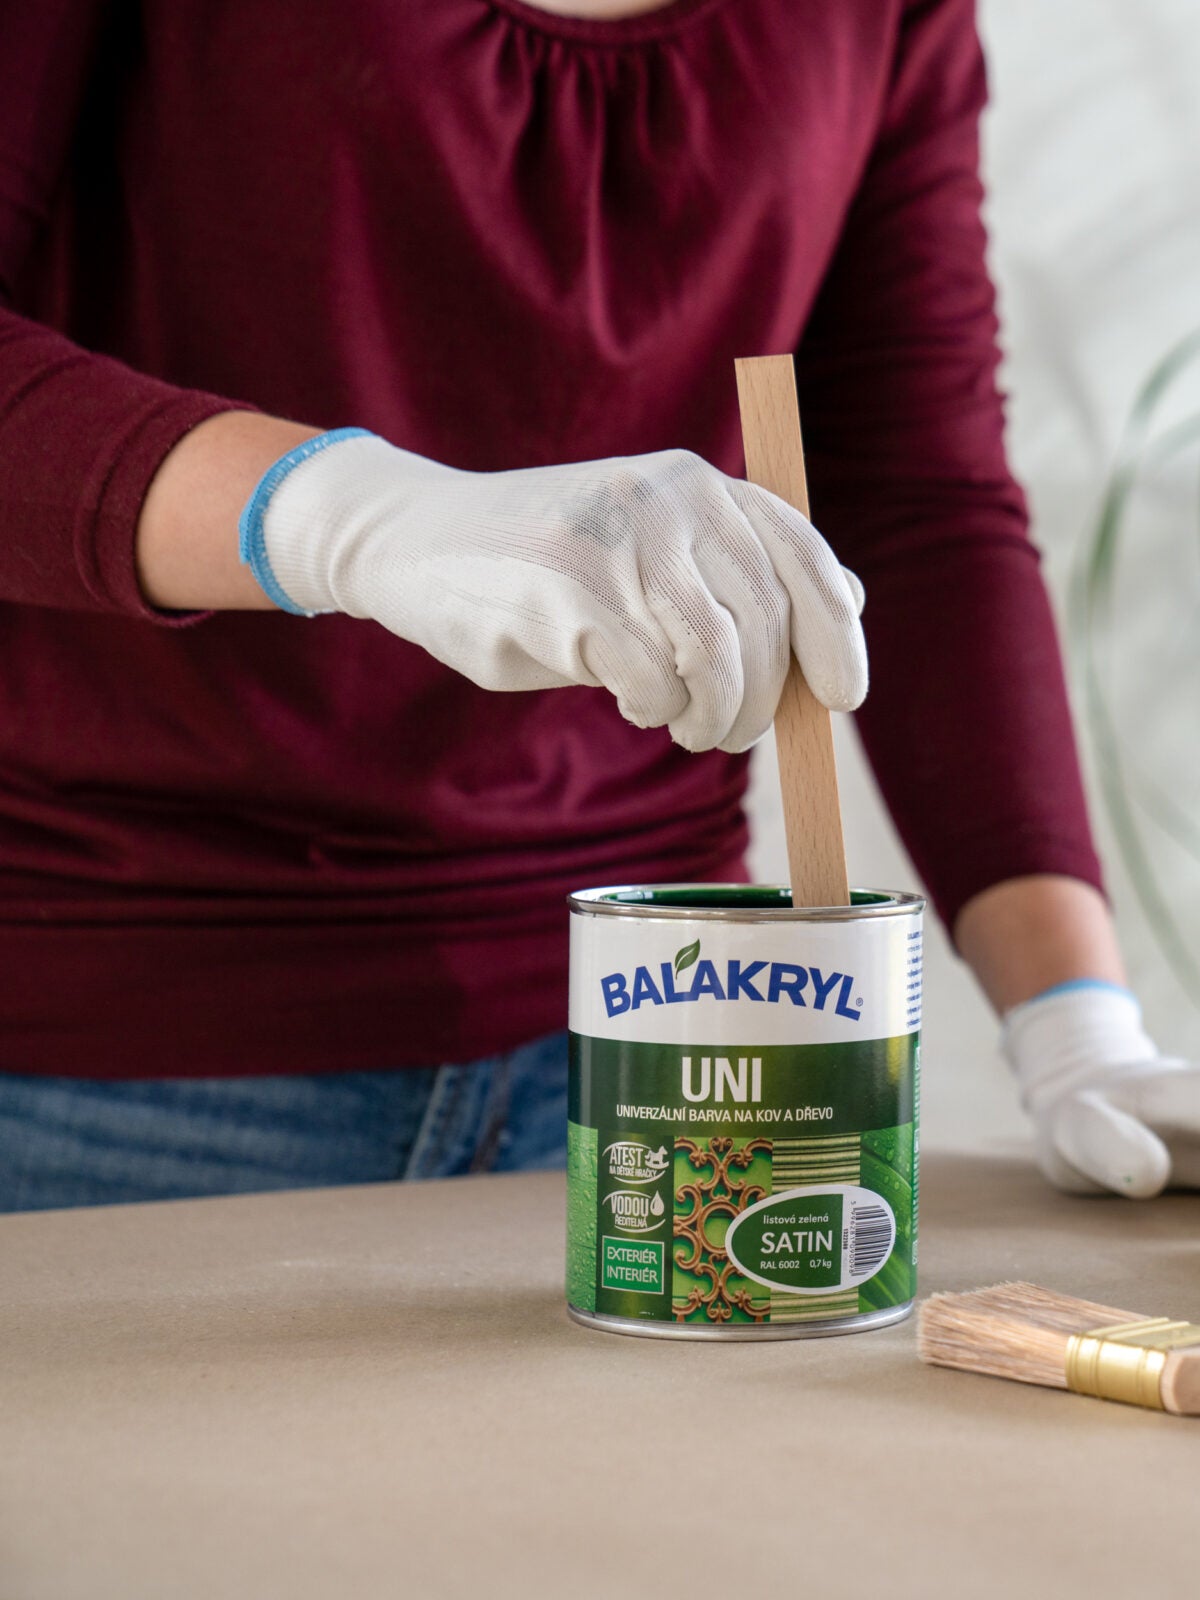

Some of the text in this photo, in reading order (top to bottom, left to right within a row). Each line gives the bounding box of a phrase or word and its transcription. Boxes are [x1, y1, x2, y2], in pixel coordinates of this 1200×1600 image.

[600, 959, 861, 1021] BALAKRYL
[681, 1056, 762, 1103] UNI
[616, 1104, 833, 1122] UNIVERZÁLNÍ BARVA NA KOV A DŘEVO
[609, 1145, 643, 1167] ATEST
[610, 1194, 649, 1217] VODOU
[763, 1212, 829, 1225] listová zelená
[760, 1230, 833, 1254] SATIN
[606, 1246, 658, 1265] EXTERIÉR
[760, 1258, 832, 1270] RAL 6002 0,7 kg
[606, 1265, 659, 1284] INTERIÉR
